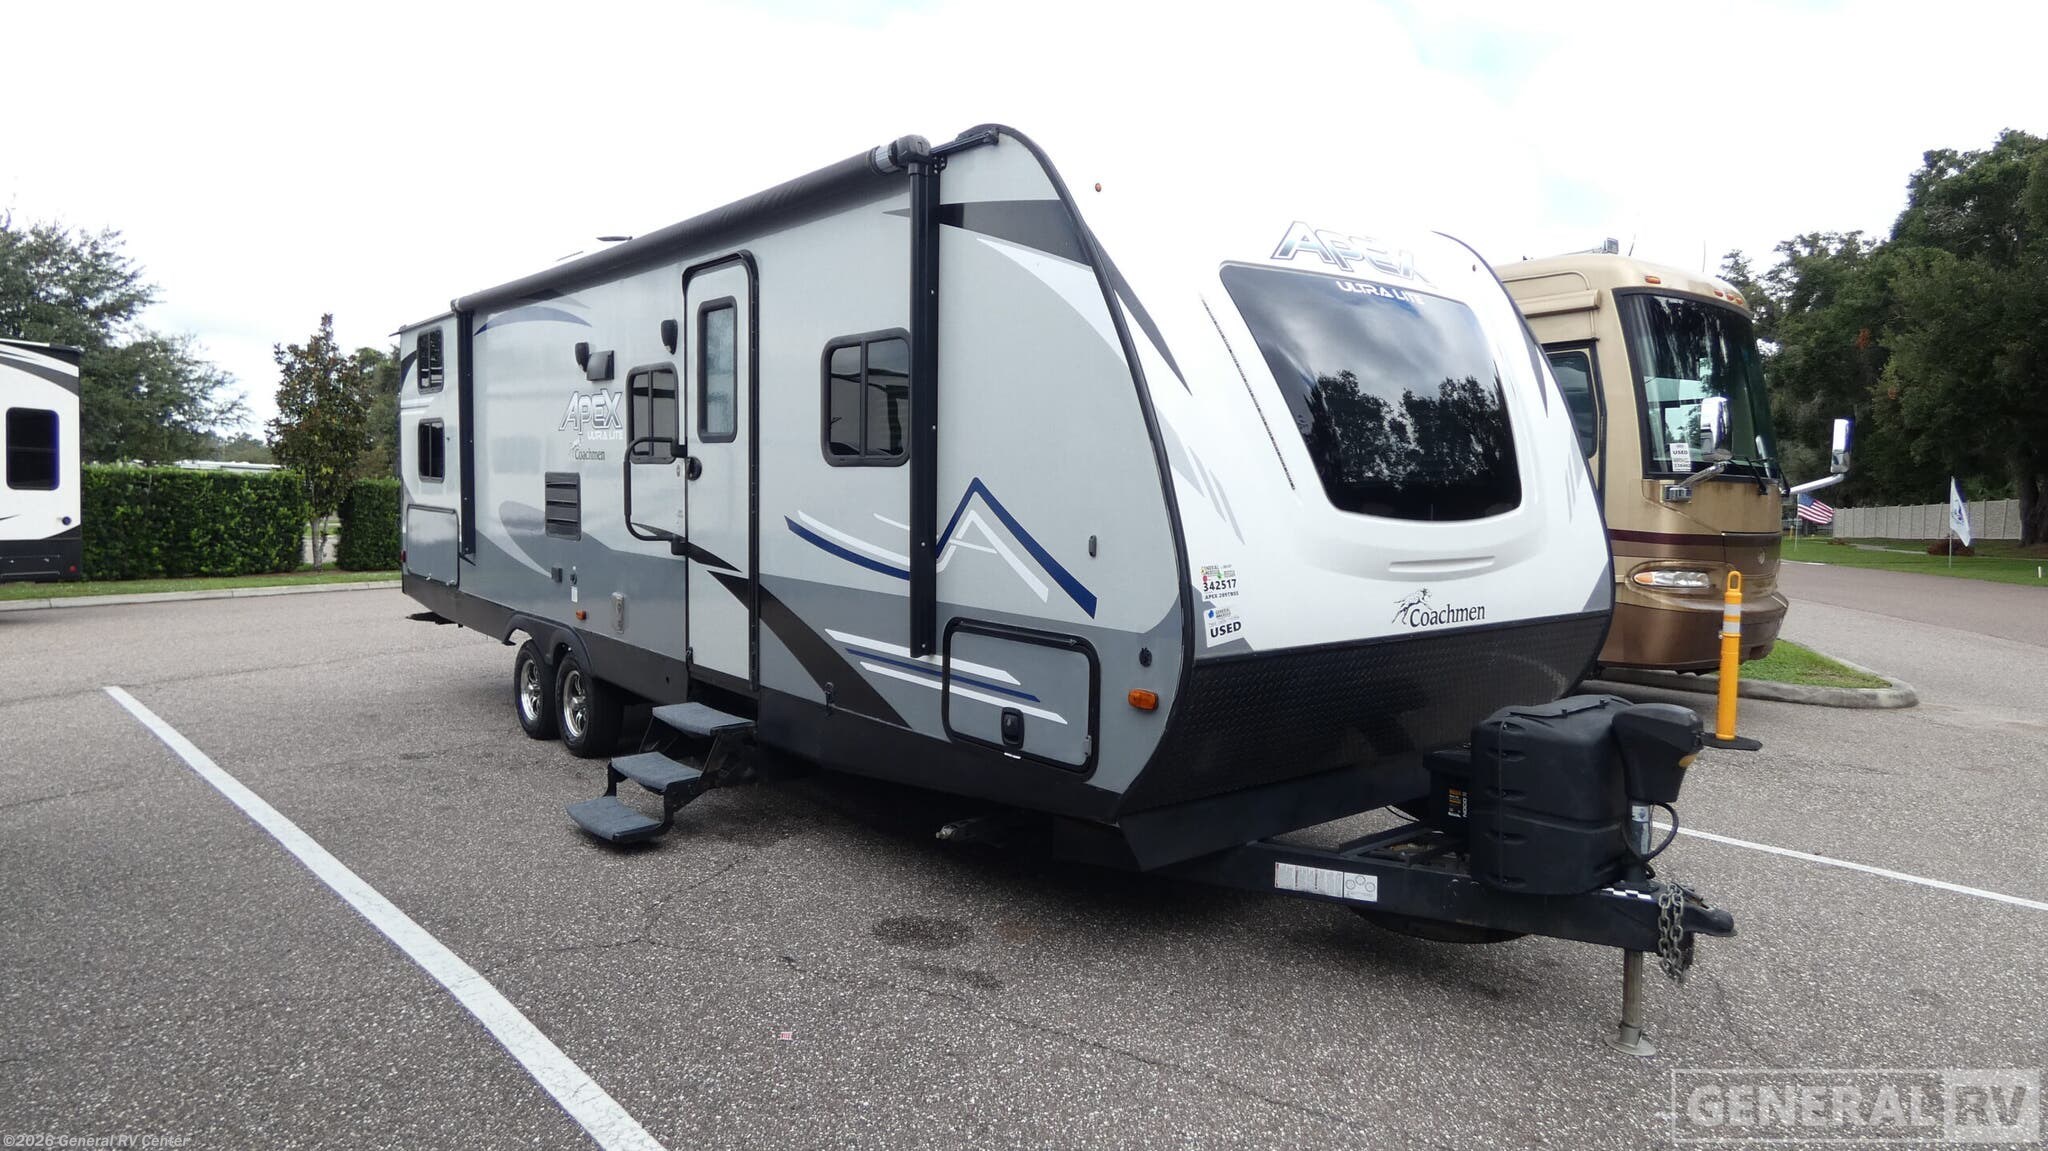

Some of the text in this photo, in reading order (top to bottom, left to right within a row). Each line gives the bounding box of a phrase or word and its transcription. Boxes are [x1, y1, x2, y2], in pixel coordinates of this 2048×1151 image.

[1335, 280, 1394, 298] ULTRA
[558, 388, 623, 435] APEX
[575, 447, 606, 461] Coachmen
[1202, 578, 1237, 593] 342517
[1409, 603, 1486, 628] Coachmen
[1210, 621, 1242, 638] USED
